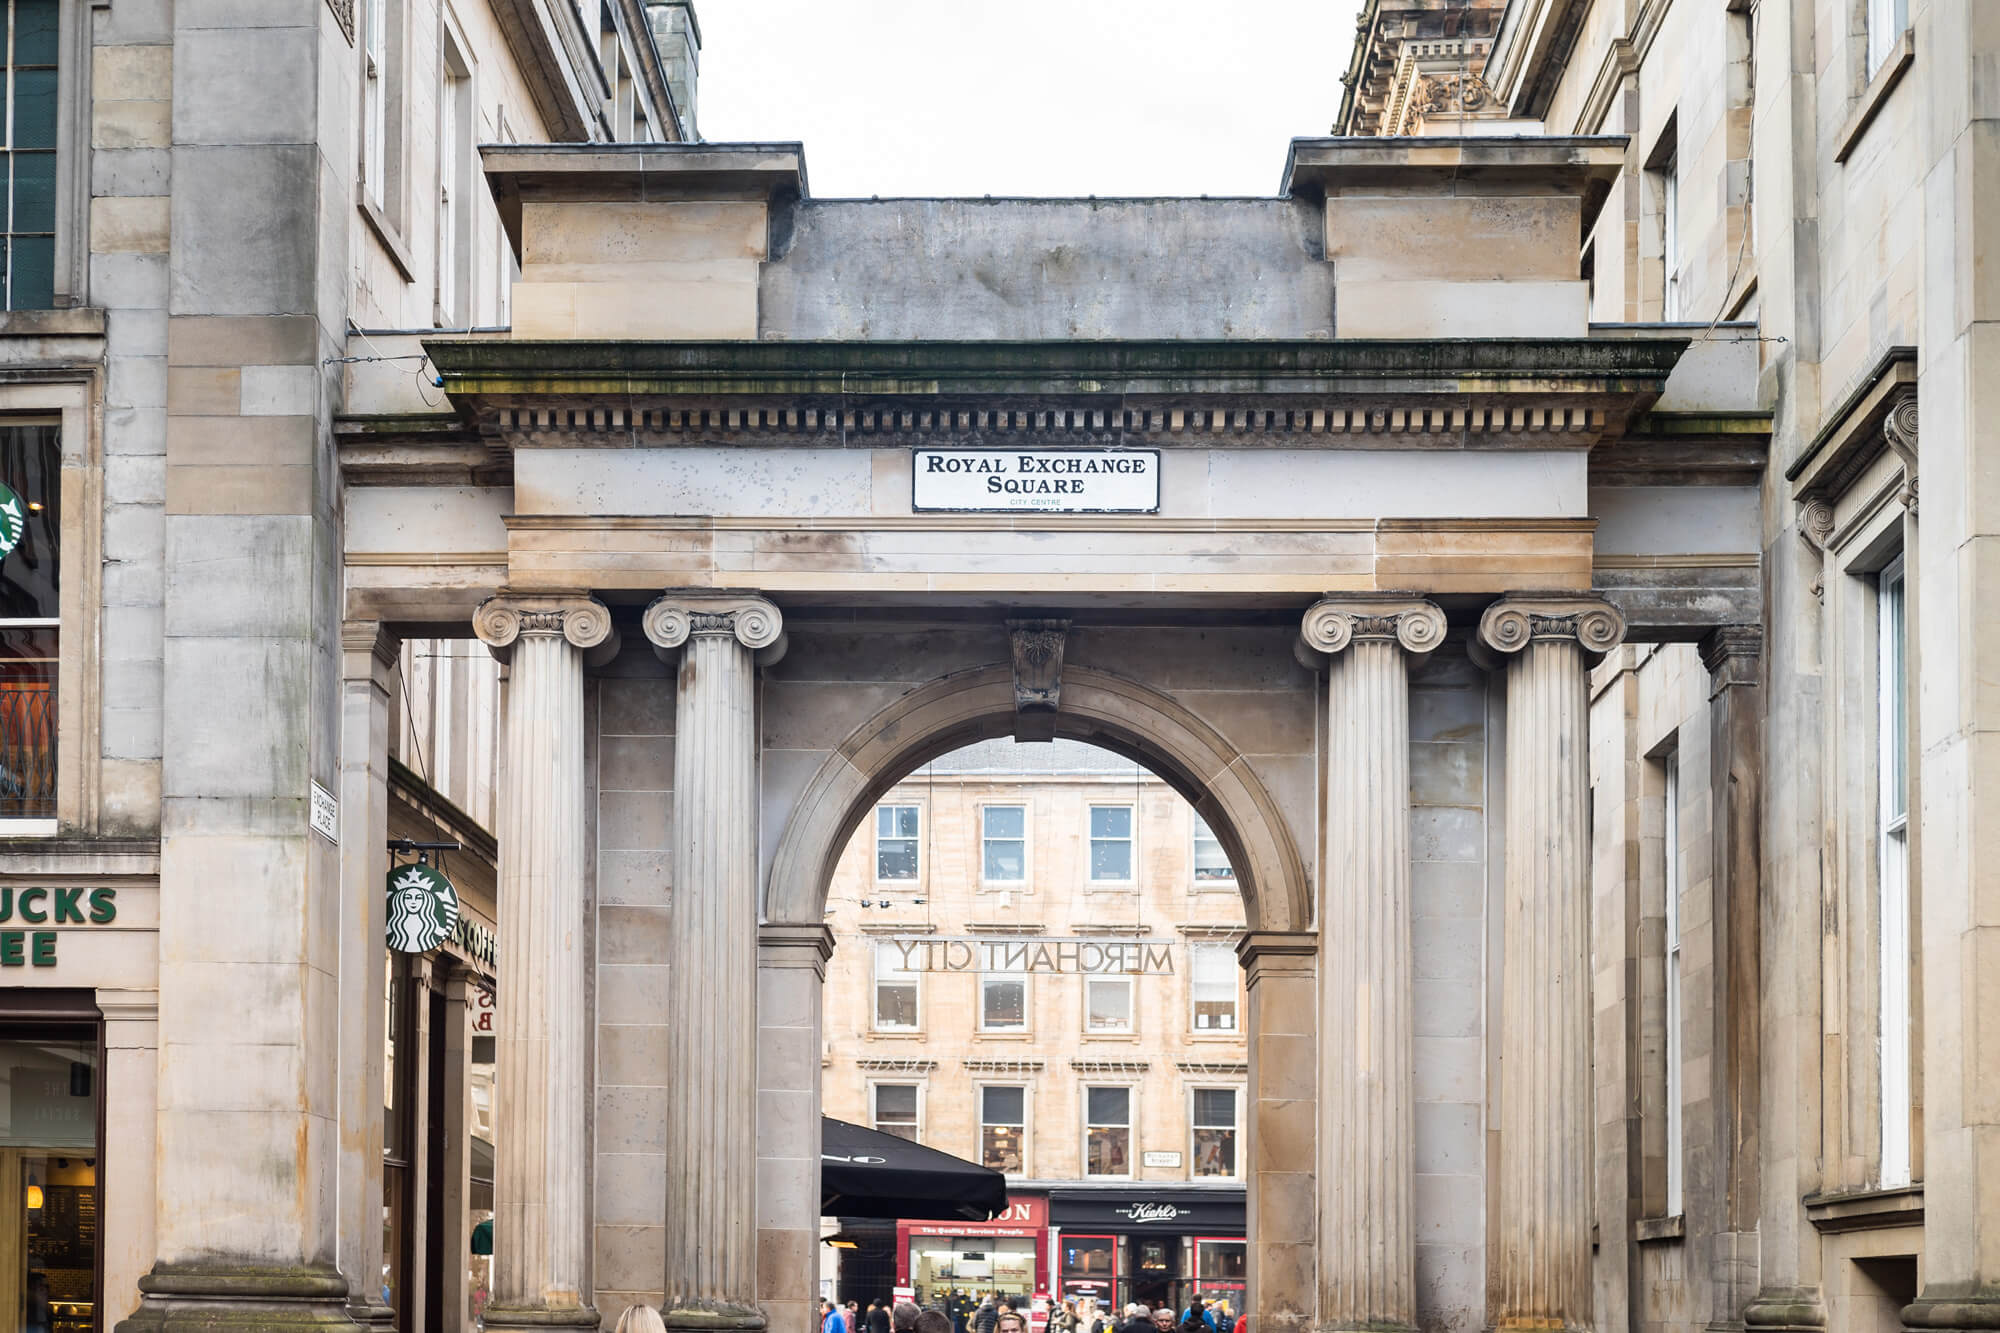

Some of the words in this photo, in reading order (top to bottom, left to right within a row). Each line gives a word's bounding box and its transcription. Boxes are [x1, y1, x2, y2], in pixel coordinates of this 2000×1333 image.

[927, 455, 1007, 473] ROYAL
[1017, 455, 1146, 474] EXCHANGE
[987, 475, 1085, 494] SQUARE
[1010, 498, 1028, 506] CITY
[1031, 498, 1061, 506] CENTRE
[317, 809, 331, 831] PLACE
